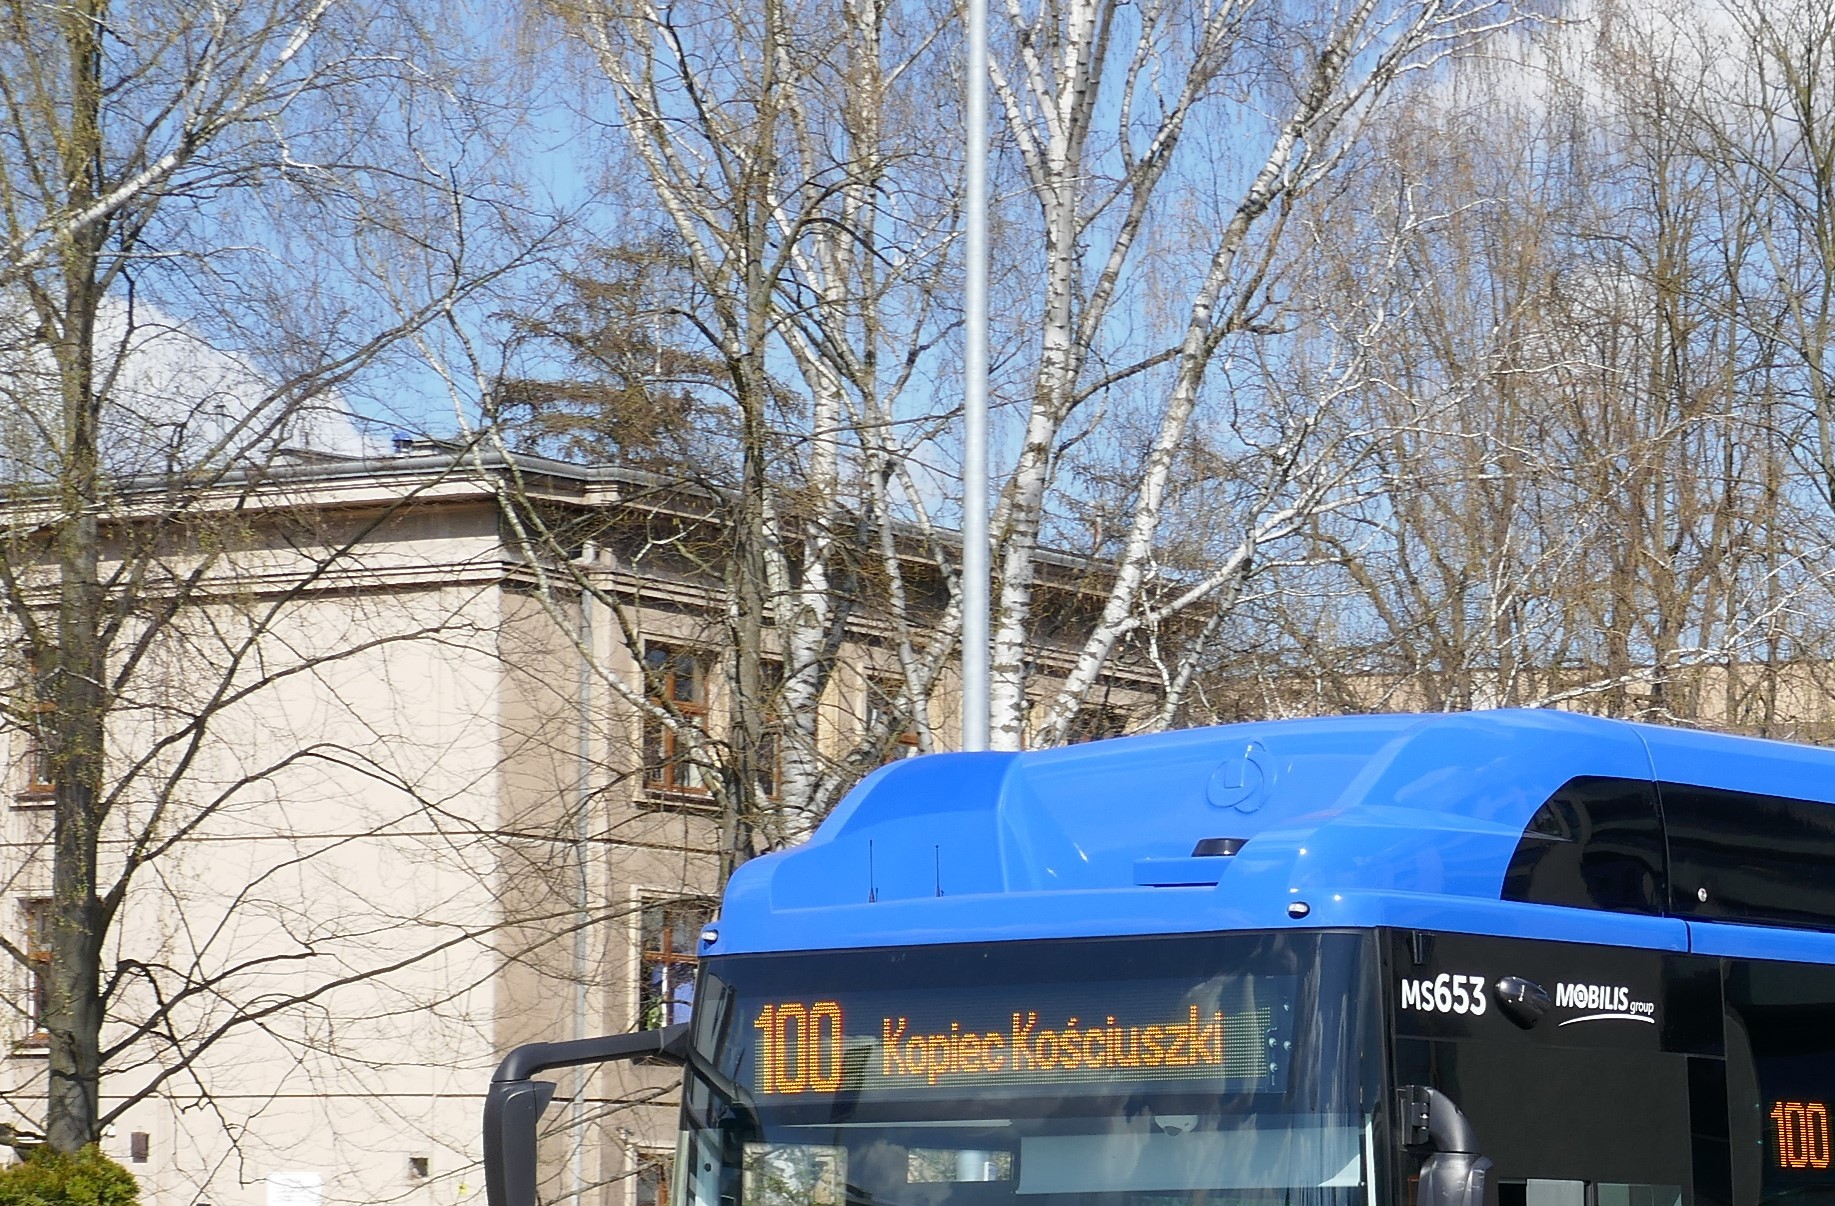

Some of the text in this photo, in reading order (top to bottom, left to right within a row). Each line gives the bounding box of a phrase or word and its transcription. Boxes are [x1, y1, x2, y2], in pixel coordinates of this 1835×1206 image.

[1401, 973, 1486, 1015] MS653
[1556, 983, 1654, 1015] MOBILIS group
[754, 1002, 842, 1094] 100
[883, 1004, 1222, 1085] Kopiec Kościuszki
[1769, 1101, 1829, 1168] 100
